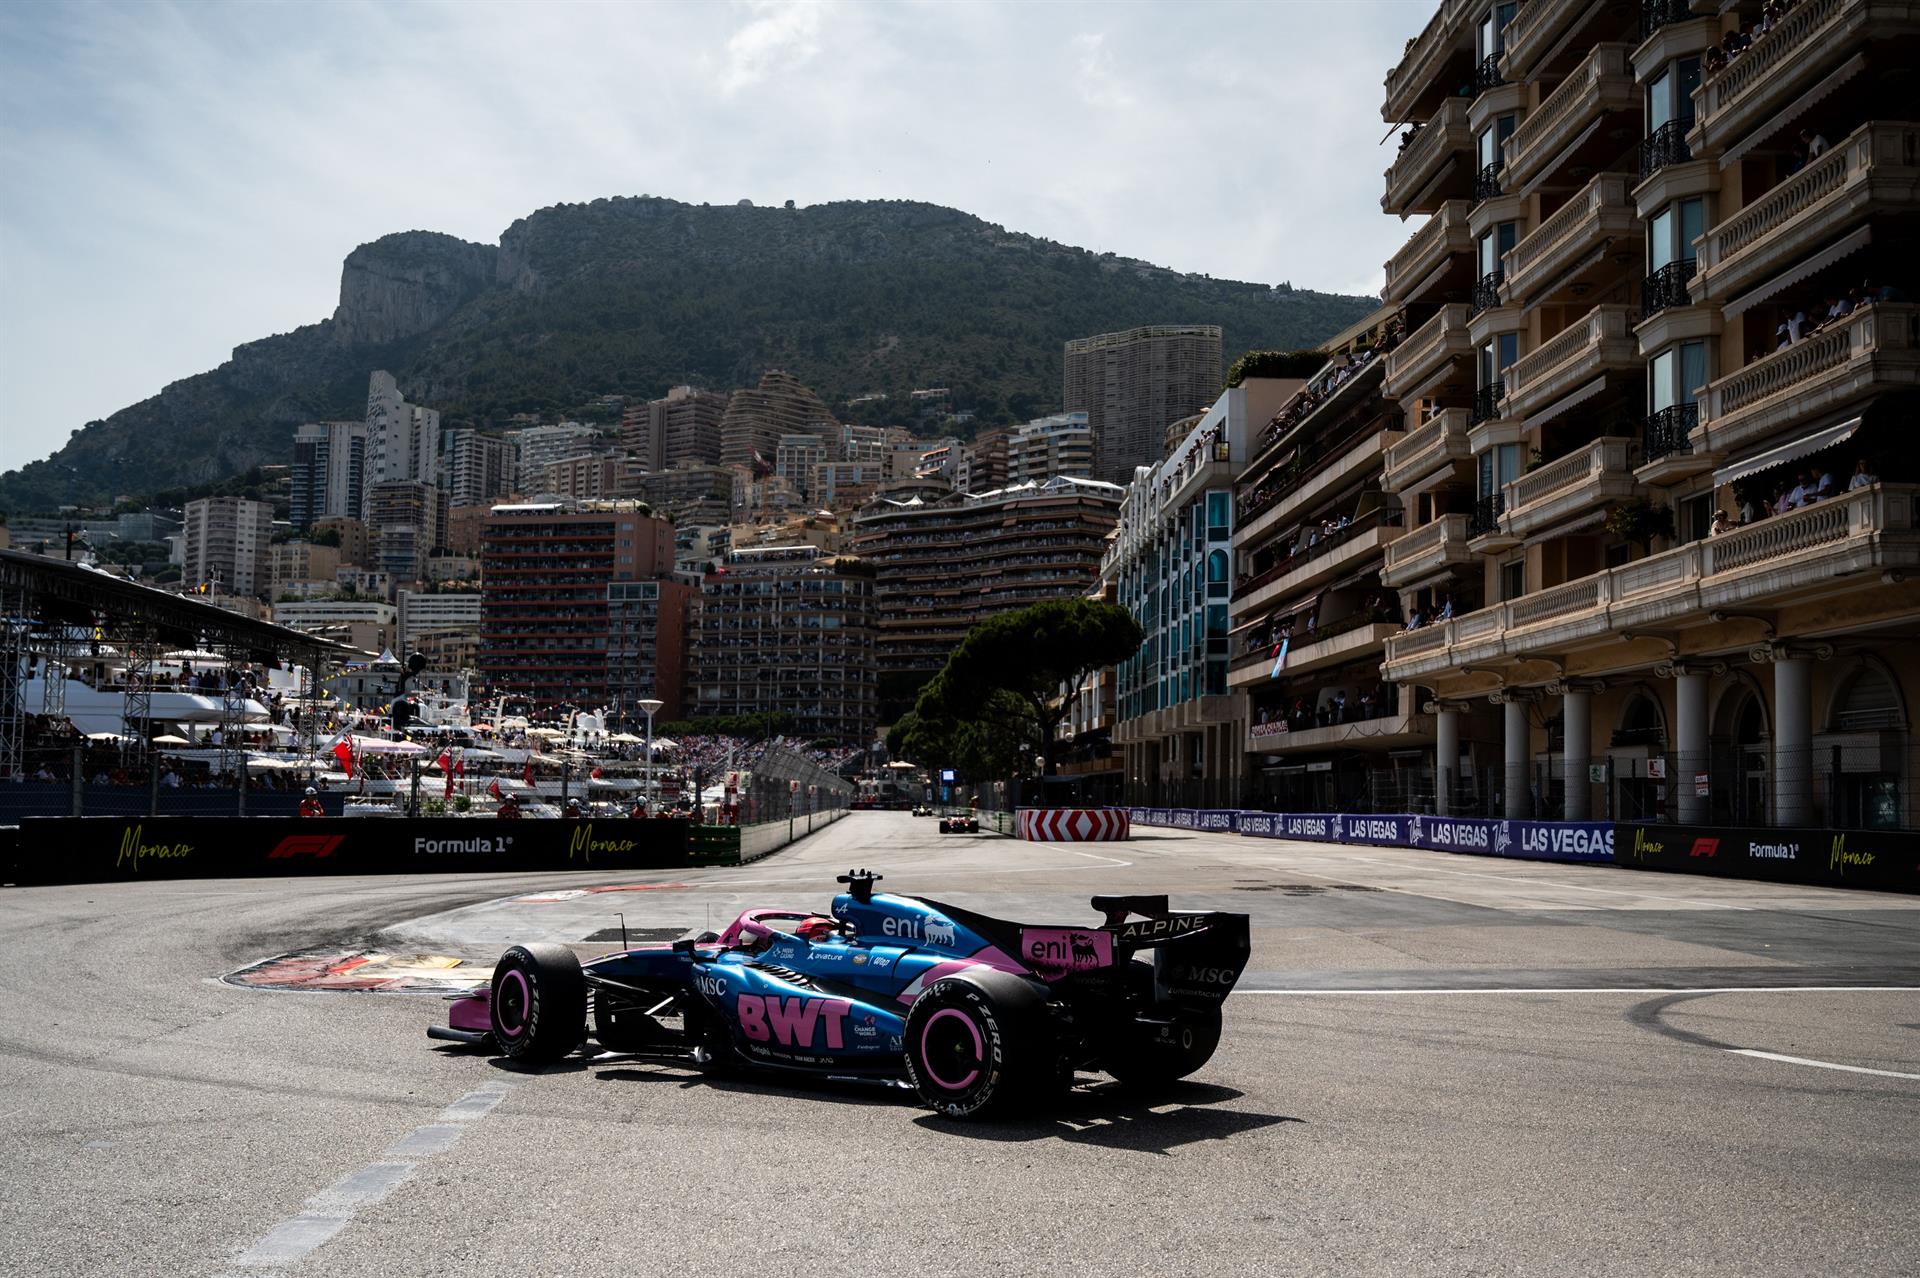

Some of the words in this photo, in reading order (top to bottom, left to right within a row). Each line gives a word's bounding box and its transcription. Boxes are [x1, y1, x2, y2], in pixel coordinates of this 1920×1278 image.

[1201, 814, 1210, 827] LAS
[1210, 815, 1230, 828] VEGAS
[1240, 817, 1251, 832] LAS
[1251, 817, 1271, 833] VEGAS
[1288, 818, 1302, 834] LAS
[1302, 818, 1326, 836] VEGAS
[1349, 819, 1366, 838] LAS
[1367, 819, 1397, 840] VEGAS
[414, 836, 492, 854] Formula
[569, 823, 638, 864] Monaco
[1431, 823, 1451, 844] LAS
[1452, 823, 1488, 847] VEGAS
[1522, 827, 1549, 852] LAS
[1550, 828, 1615, 855] VEGAS
[1634, 827, 1665, 862] Monaco
[116, 824, 195, 873] Monaco
[1749, 842, 1788, 859] Formula
[1830, 832, 1876, 877] Monaco
[883, 914, 921, 939] eni
[1122, 916, 1206, 938] ALPINE
[815, 952, 844, 961] avature
[1031, 936, 1068, 961] eni
[697, 976, 727, 997] MSC
[1187, 965, 1235, 985] MSC
[737, 993, 850, 1049] BWT
[966, 992, 980, 1002] P
[978, 1004, 1002, 1063] ZERO
